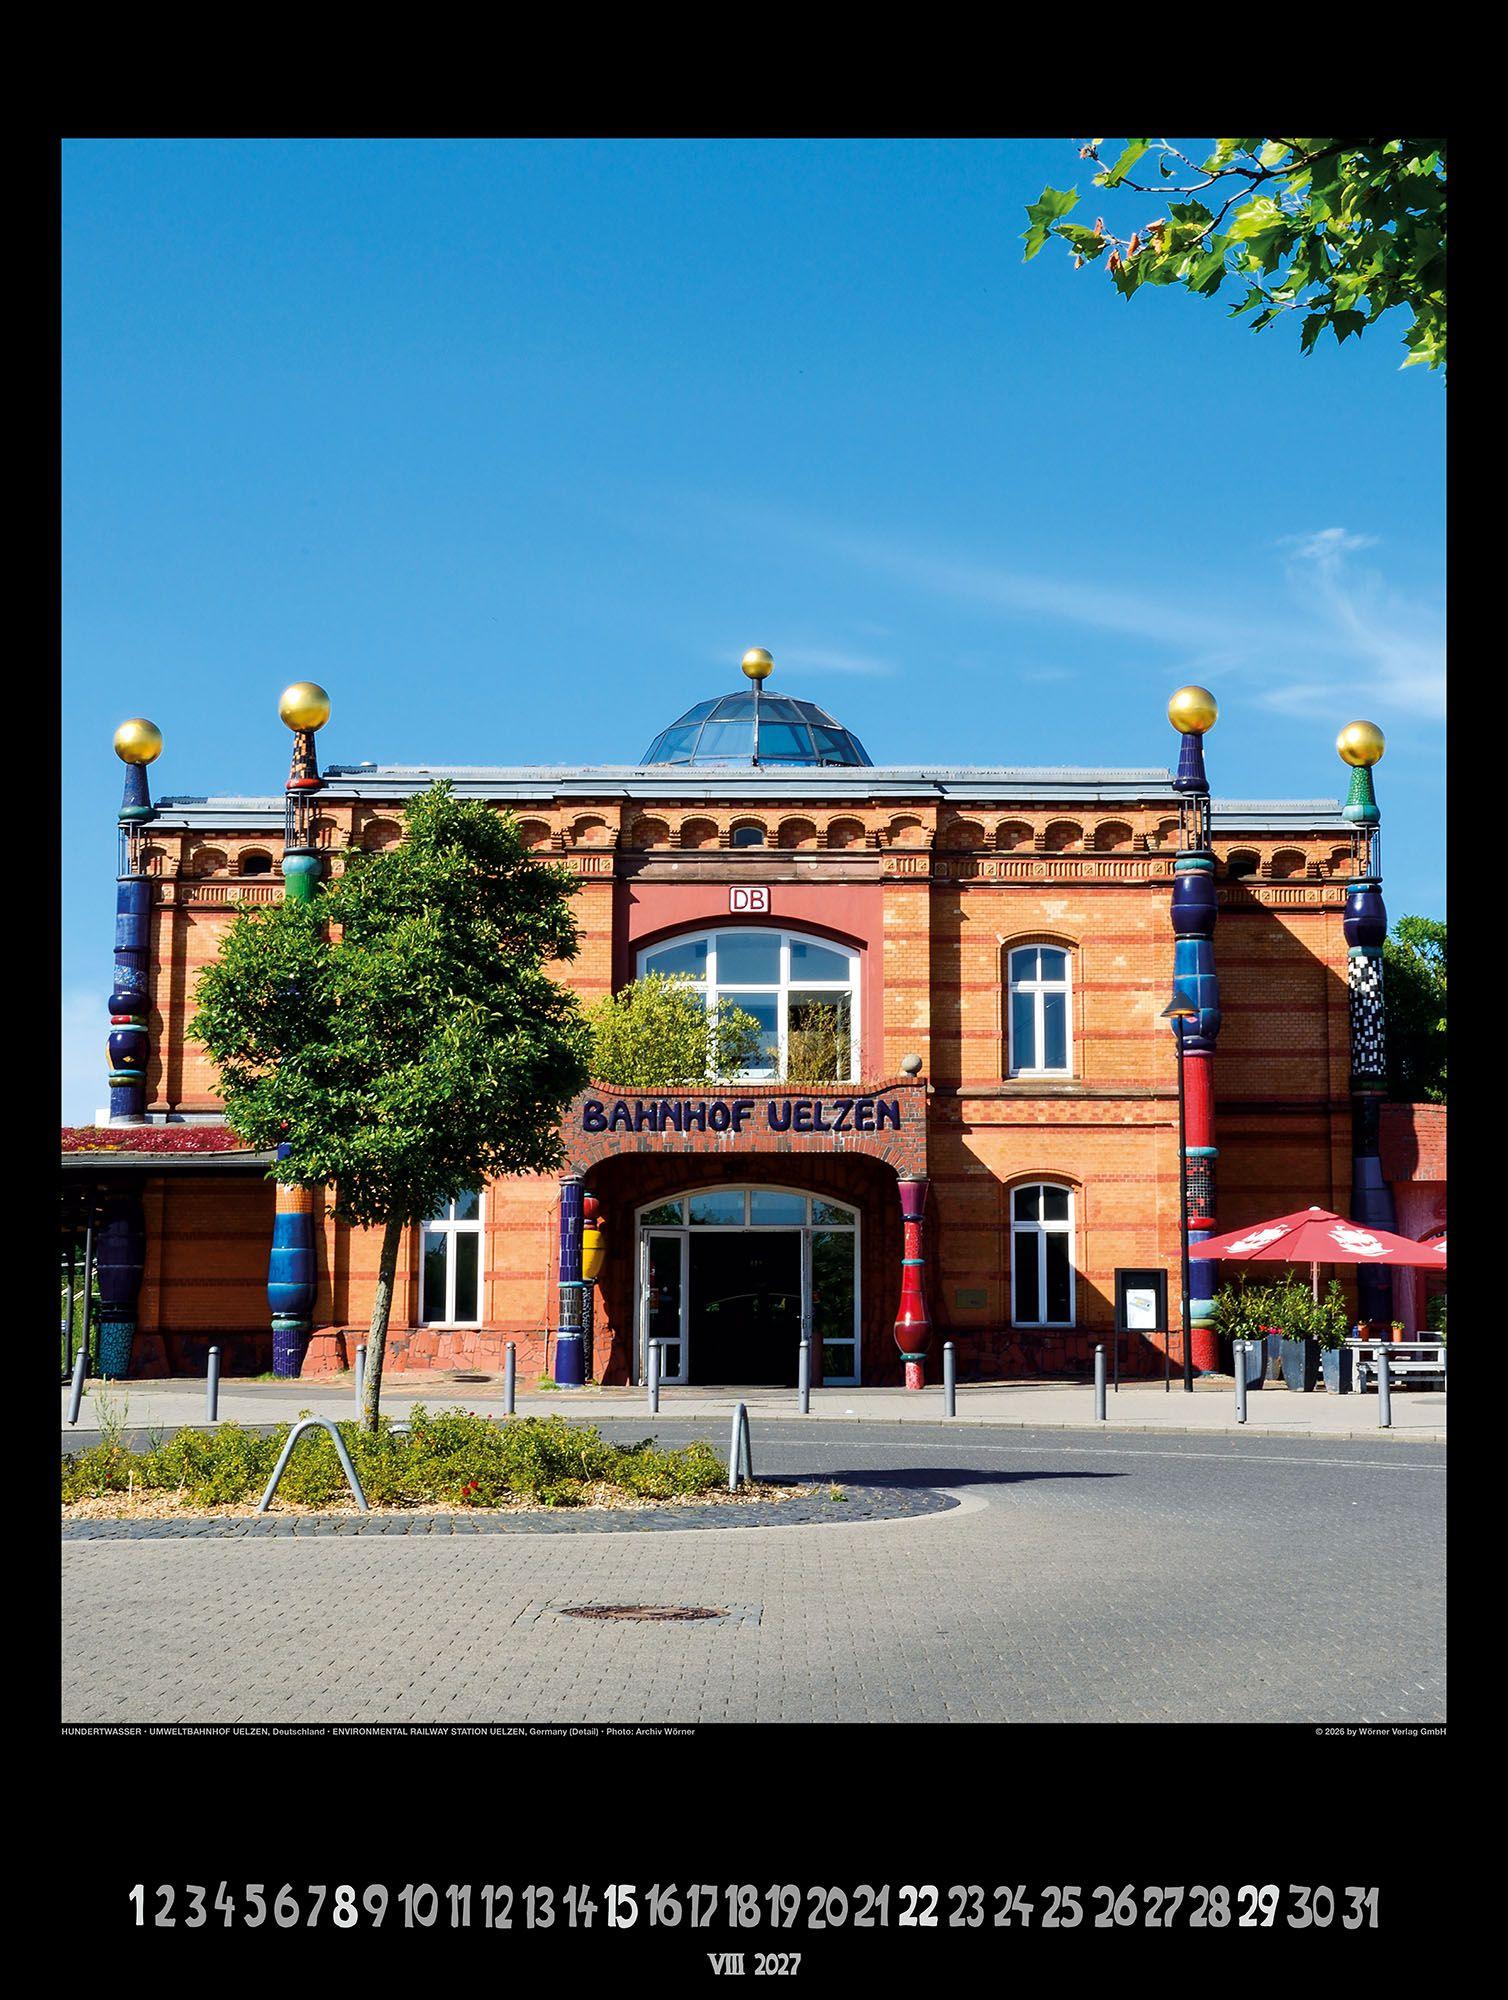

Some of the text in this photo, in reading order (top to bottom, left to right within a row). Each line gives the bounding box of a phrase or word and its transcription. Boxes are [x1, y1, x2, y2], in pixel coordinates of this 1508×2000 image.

[734, 889, 765, 910] DB
[582, 1099, 900, 1132] BAHNHOF UELZEN
